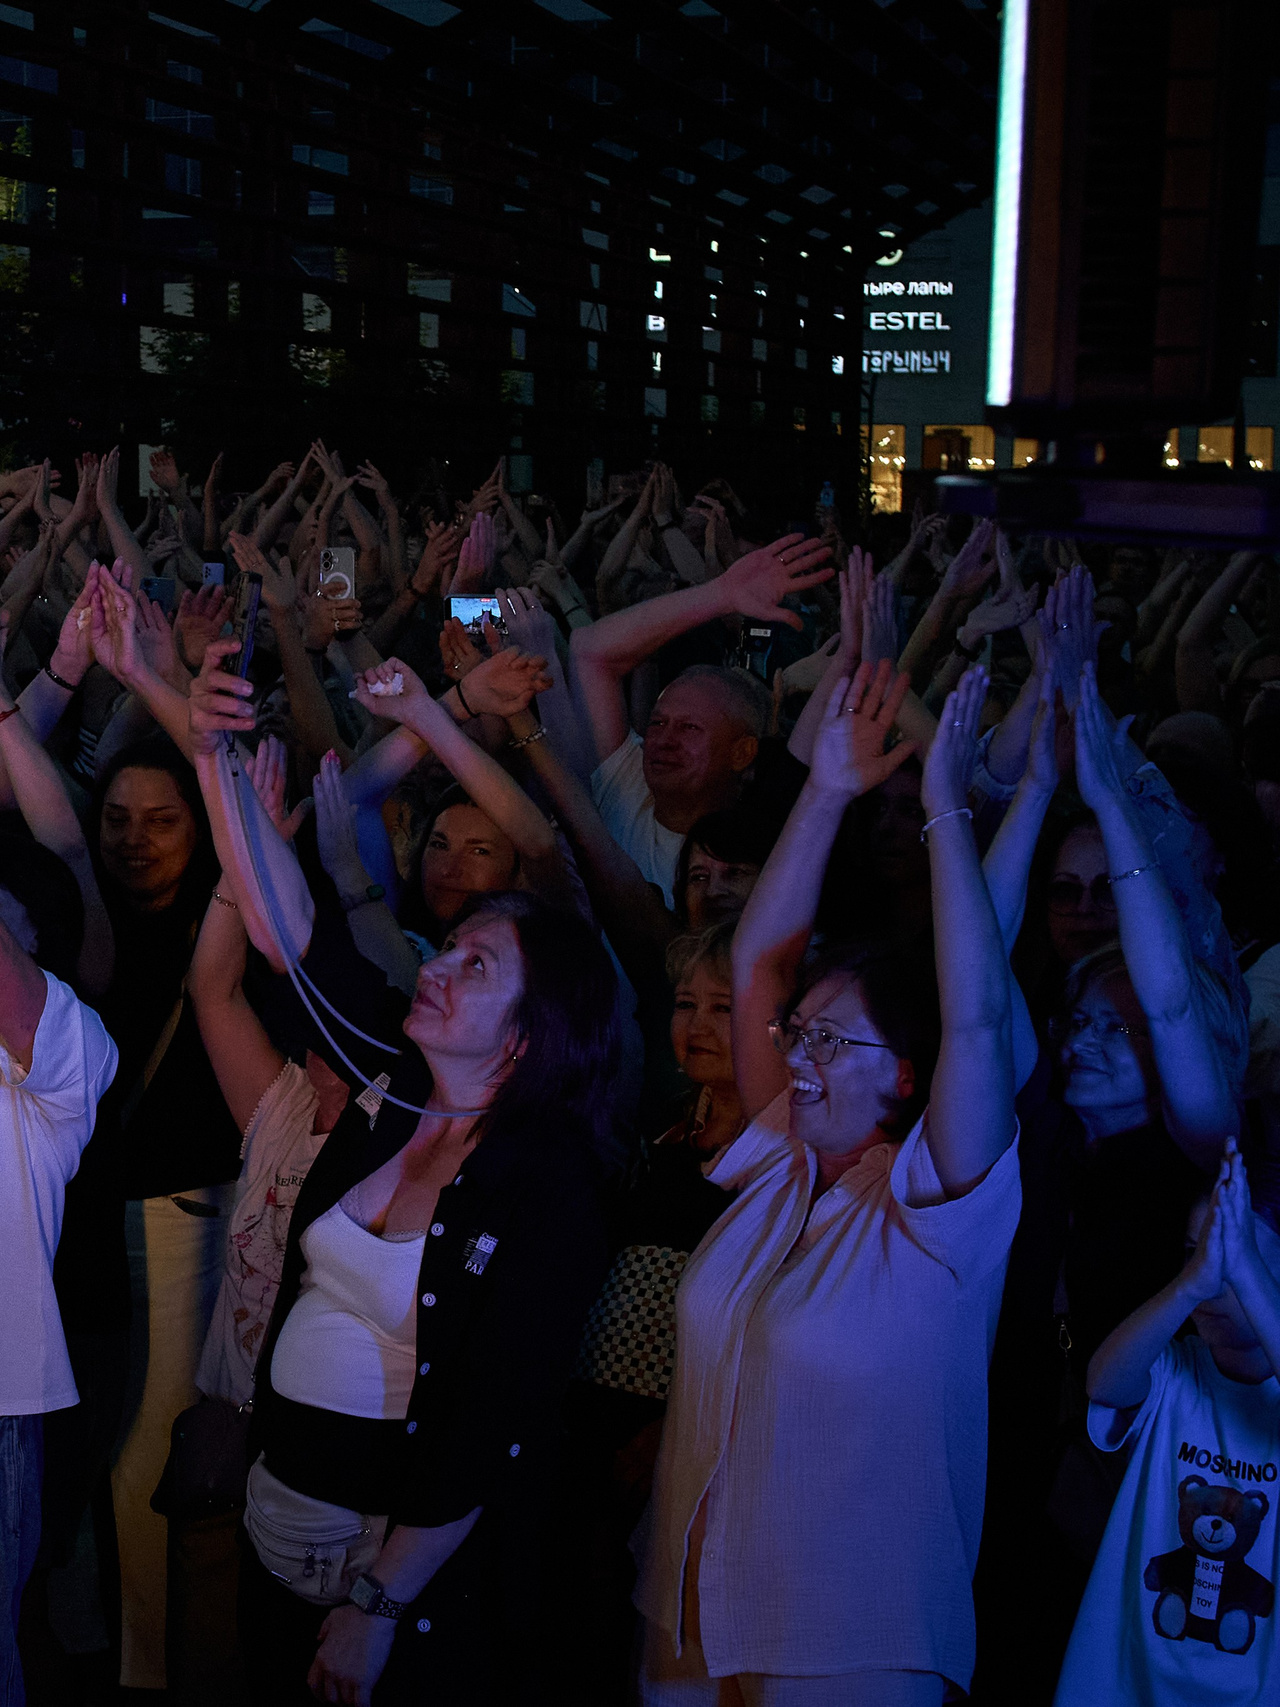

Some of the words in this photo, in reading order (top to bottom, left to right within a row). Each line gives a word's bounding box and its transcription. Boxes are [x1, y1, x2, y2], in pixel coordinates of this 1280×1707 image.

[907, 281, 953, 296] лапы
[869, 311, 951, 331] ESTEL
[1202, 1562, 1210, 1571] IS
[1196, 1596, 1213, 1608] TOY
